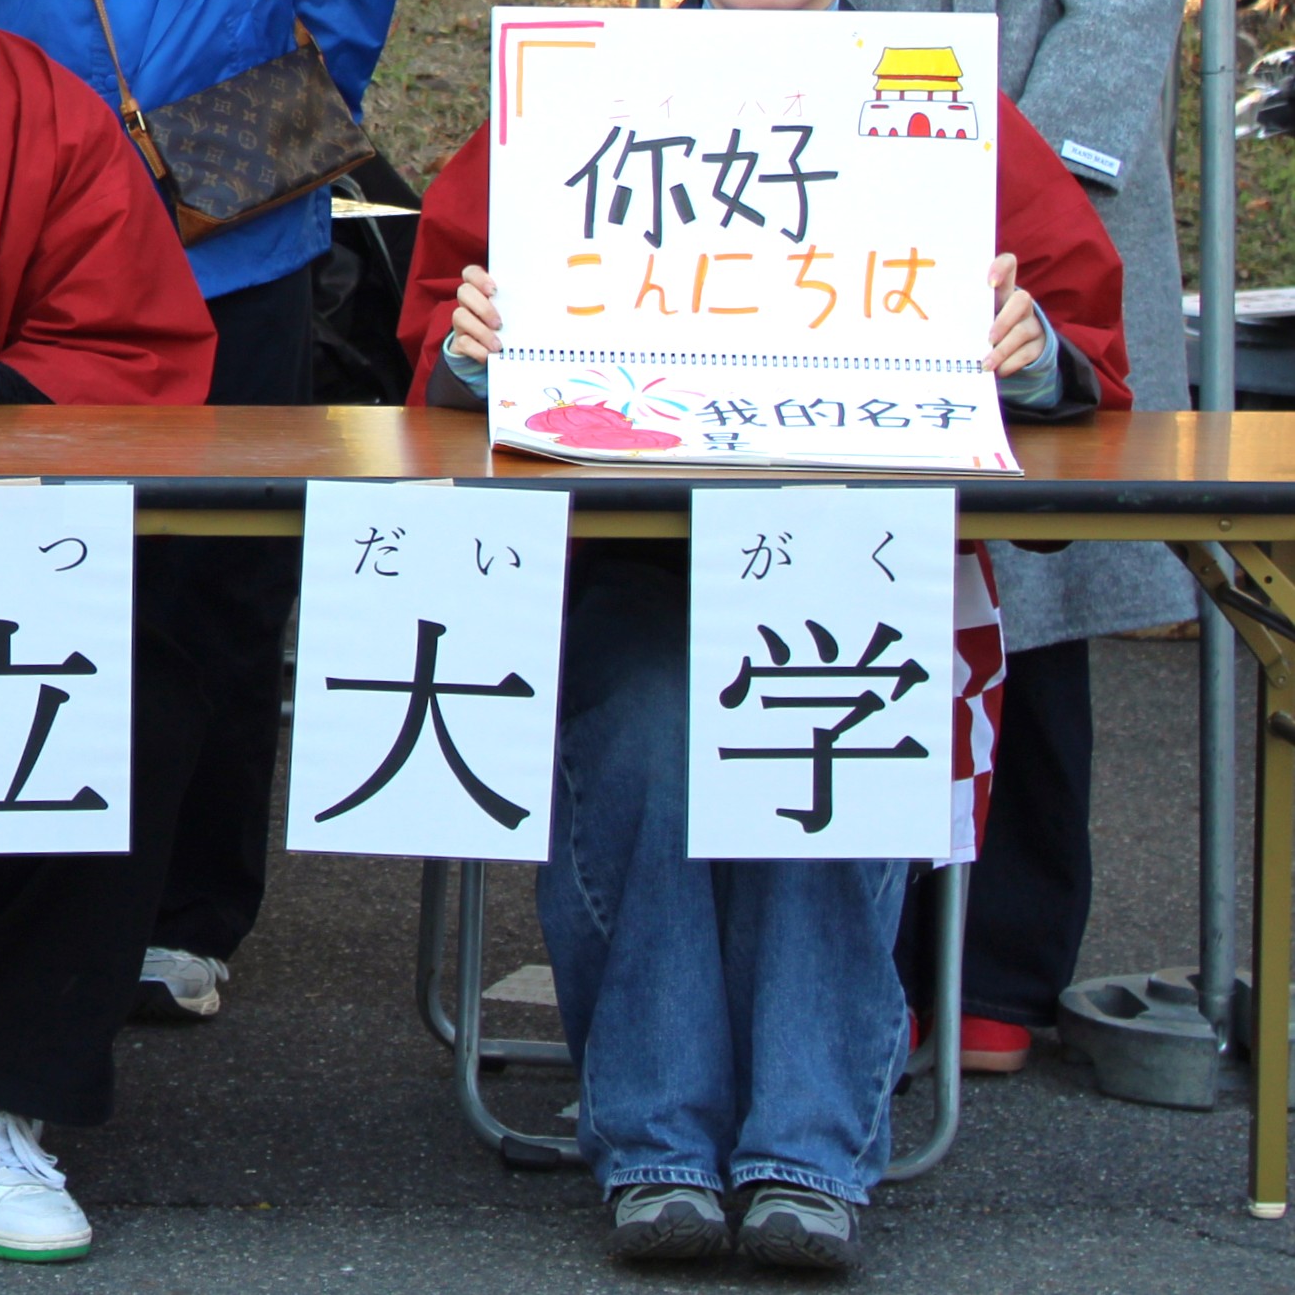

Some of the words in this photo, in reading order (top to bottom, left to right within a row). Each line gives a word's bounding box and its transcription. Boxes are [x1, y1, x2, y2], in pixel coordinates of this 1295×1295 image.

[564, 126, 838, 248] 你好
[566, 244, 937, 329] こんにちは
[694, 397, 978, 429] 我的名字
[314, 619, 536, 831] 大
[718, 619, 931, 834] 学
